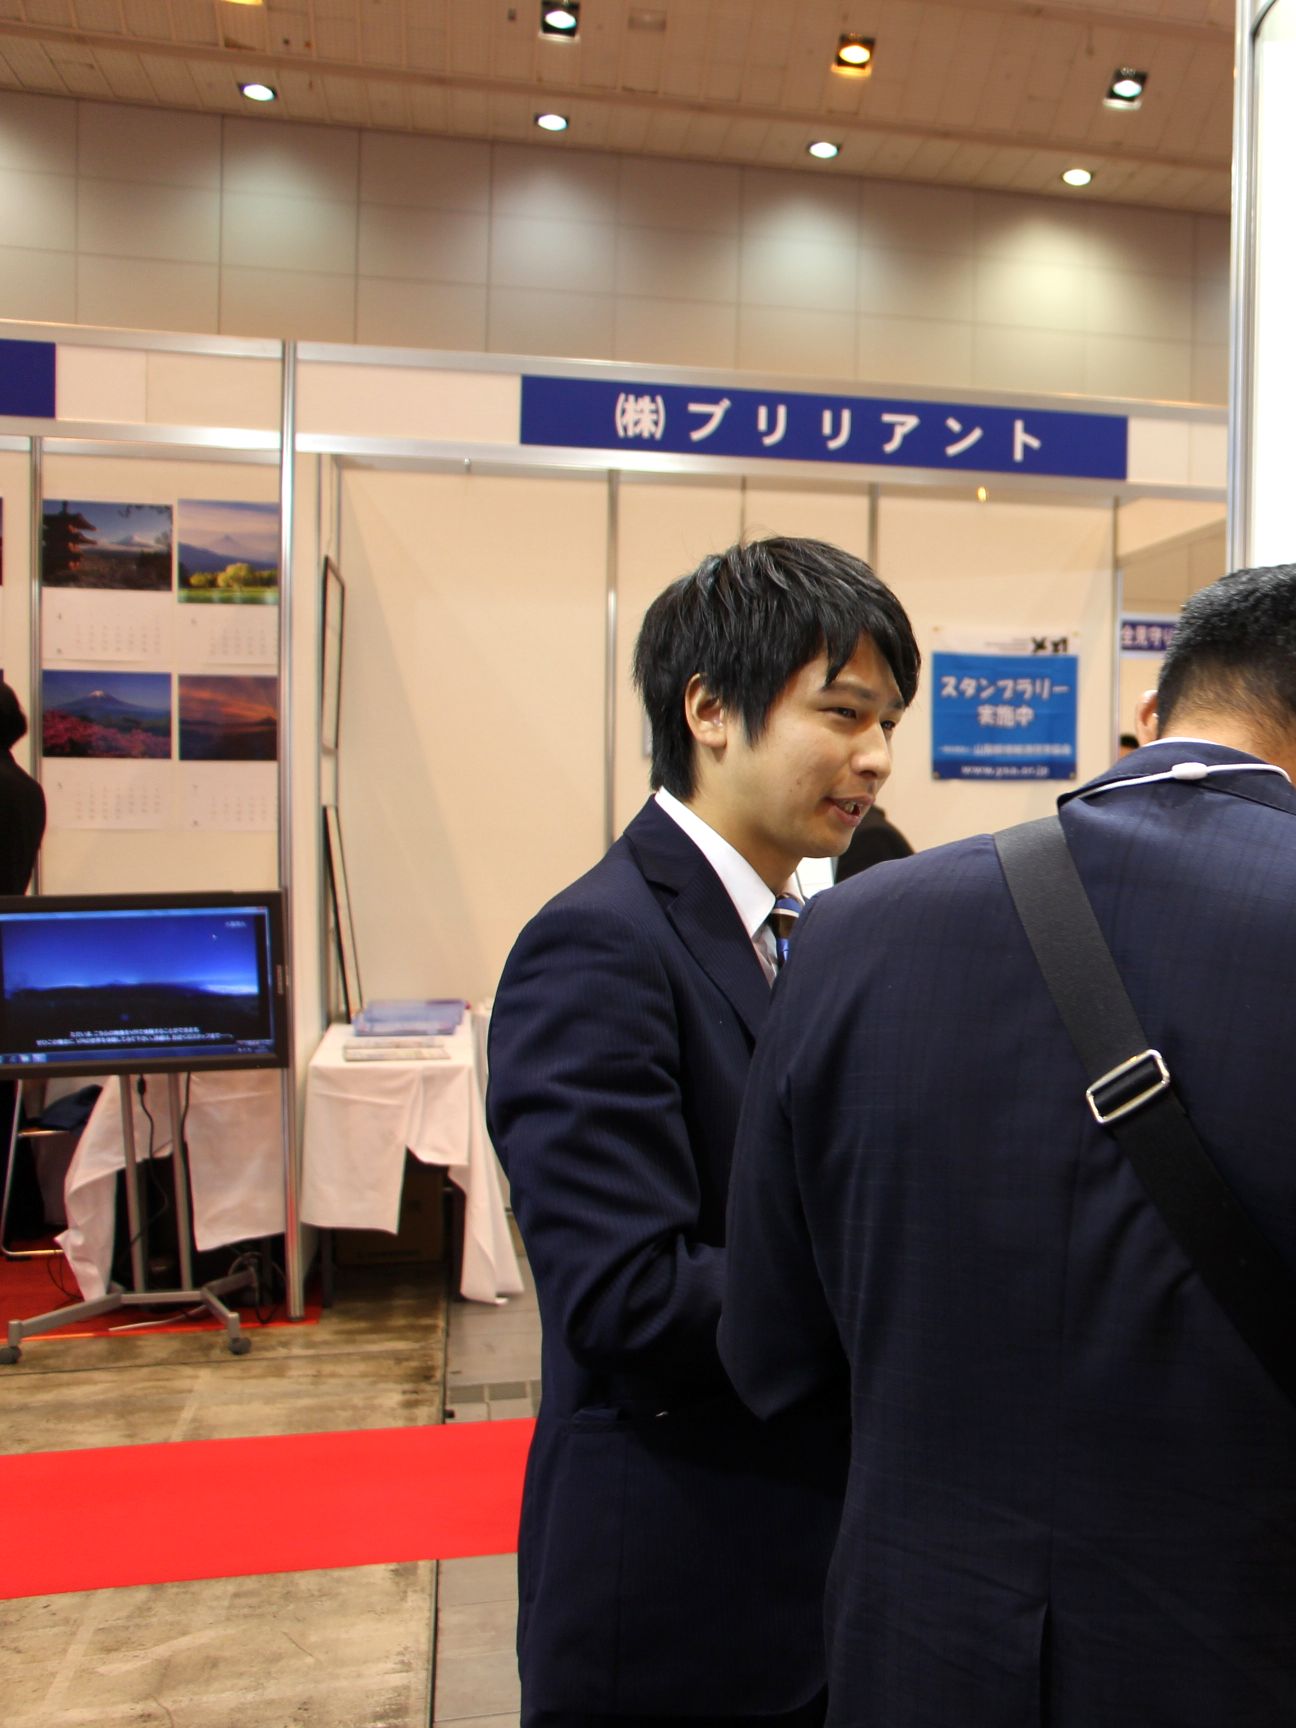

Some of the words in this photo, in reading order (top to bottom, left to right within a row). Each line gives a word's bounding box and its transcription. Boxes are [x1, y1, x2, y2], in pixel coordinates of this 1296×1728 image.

[939, 675, 1070, 700] スタンプラリー
[976, 703, 1035, 728] 実施中
